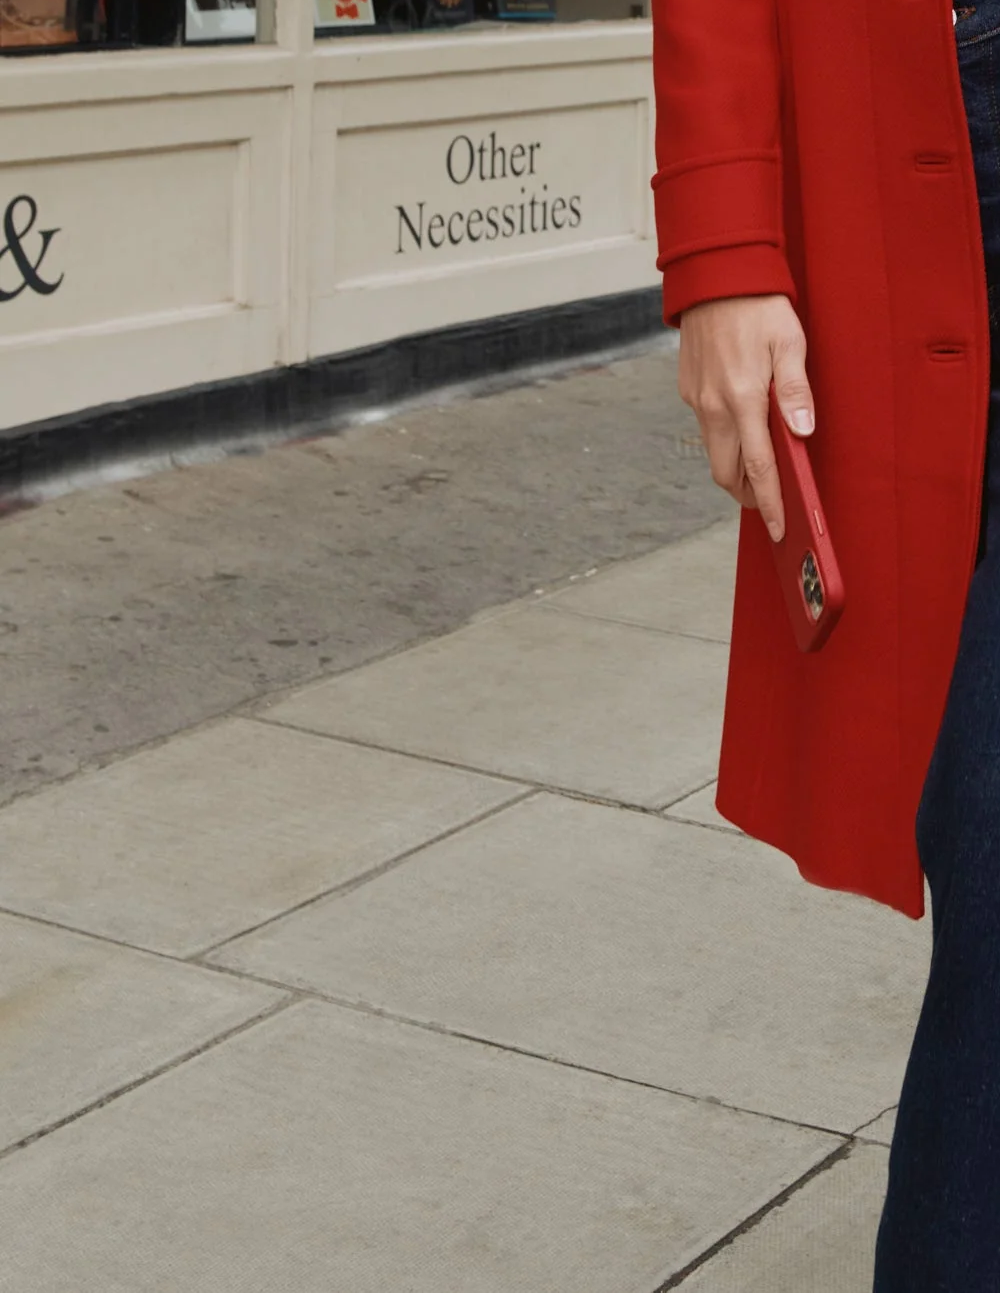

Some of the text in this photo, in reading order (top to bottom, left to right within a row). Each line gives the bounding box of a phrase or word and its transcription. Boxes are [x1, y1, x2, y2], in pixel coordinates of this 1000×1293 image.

[446, 131, 541, 185] Other
[0, 194, 64, 302] &
[395, 184, 582, 254] Necessities
